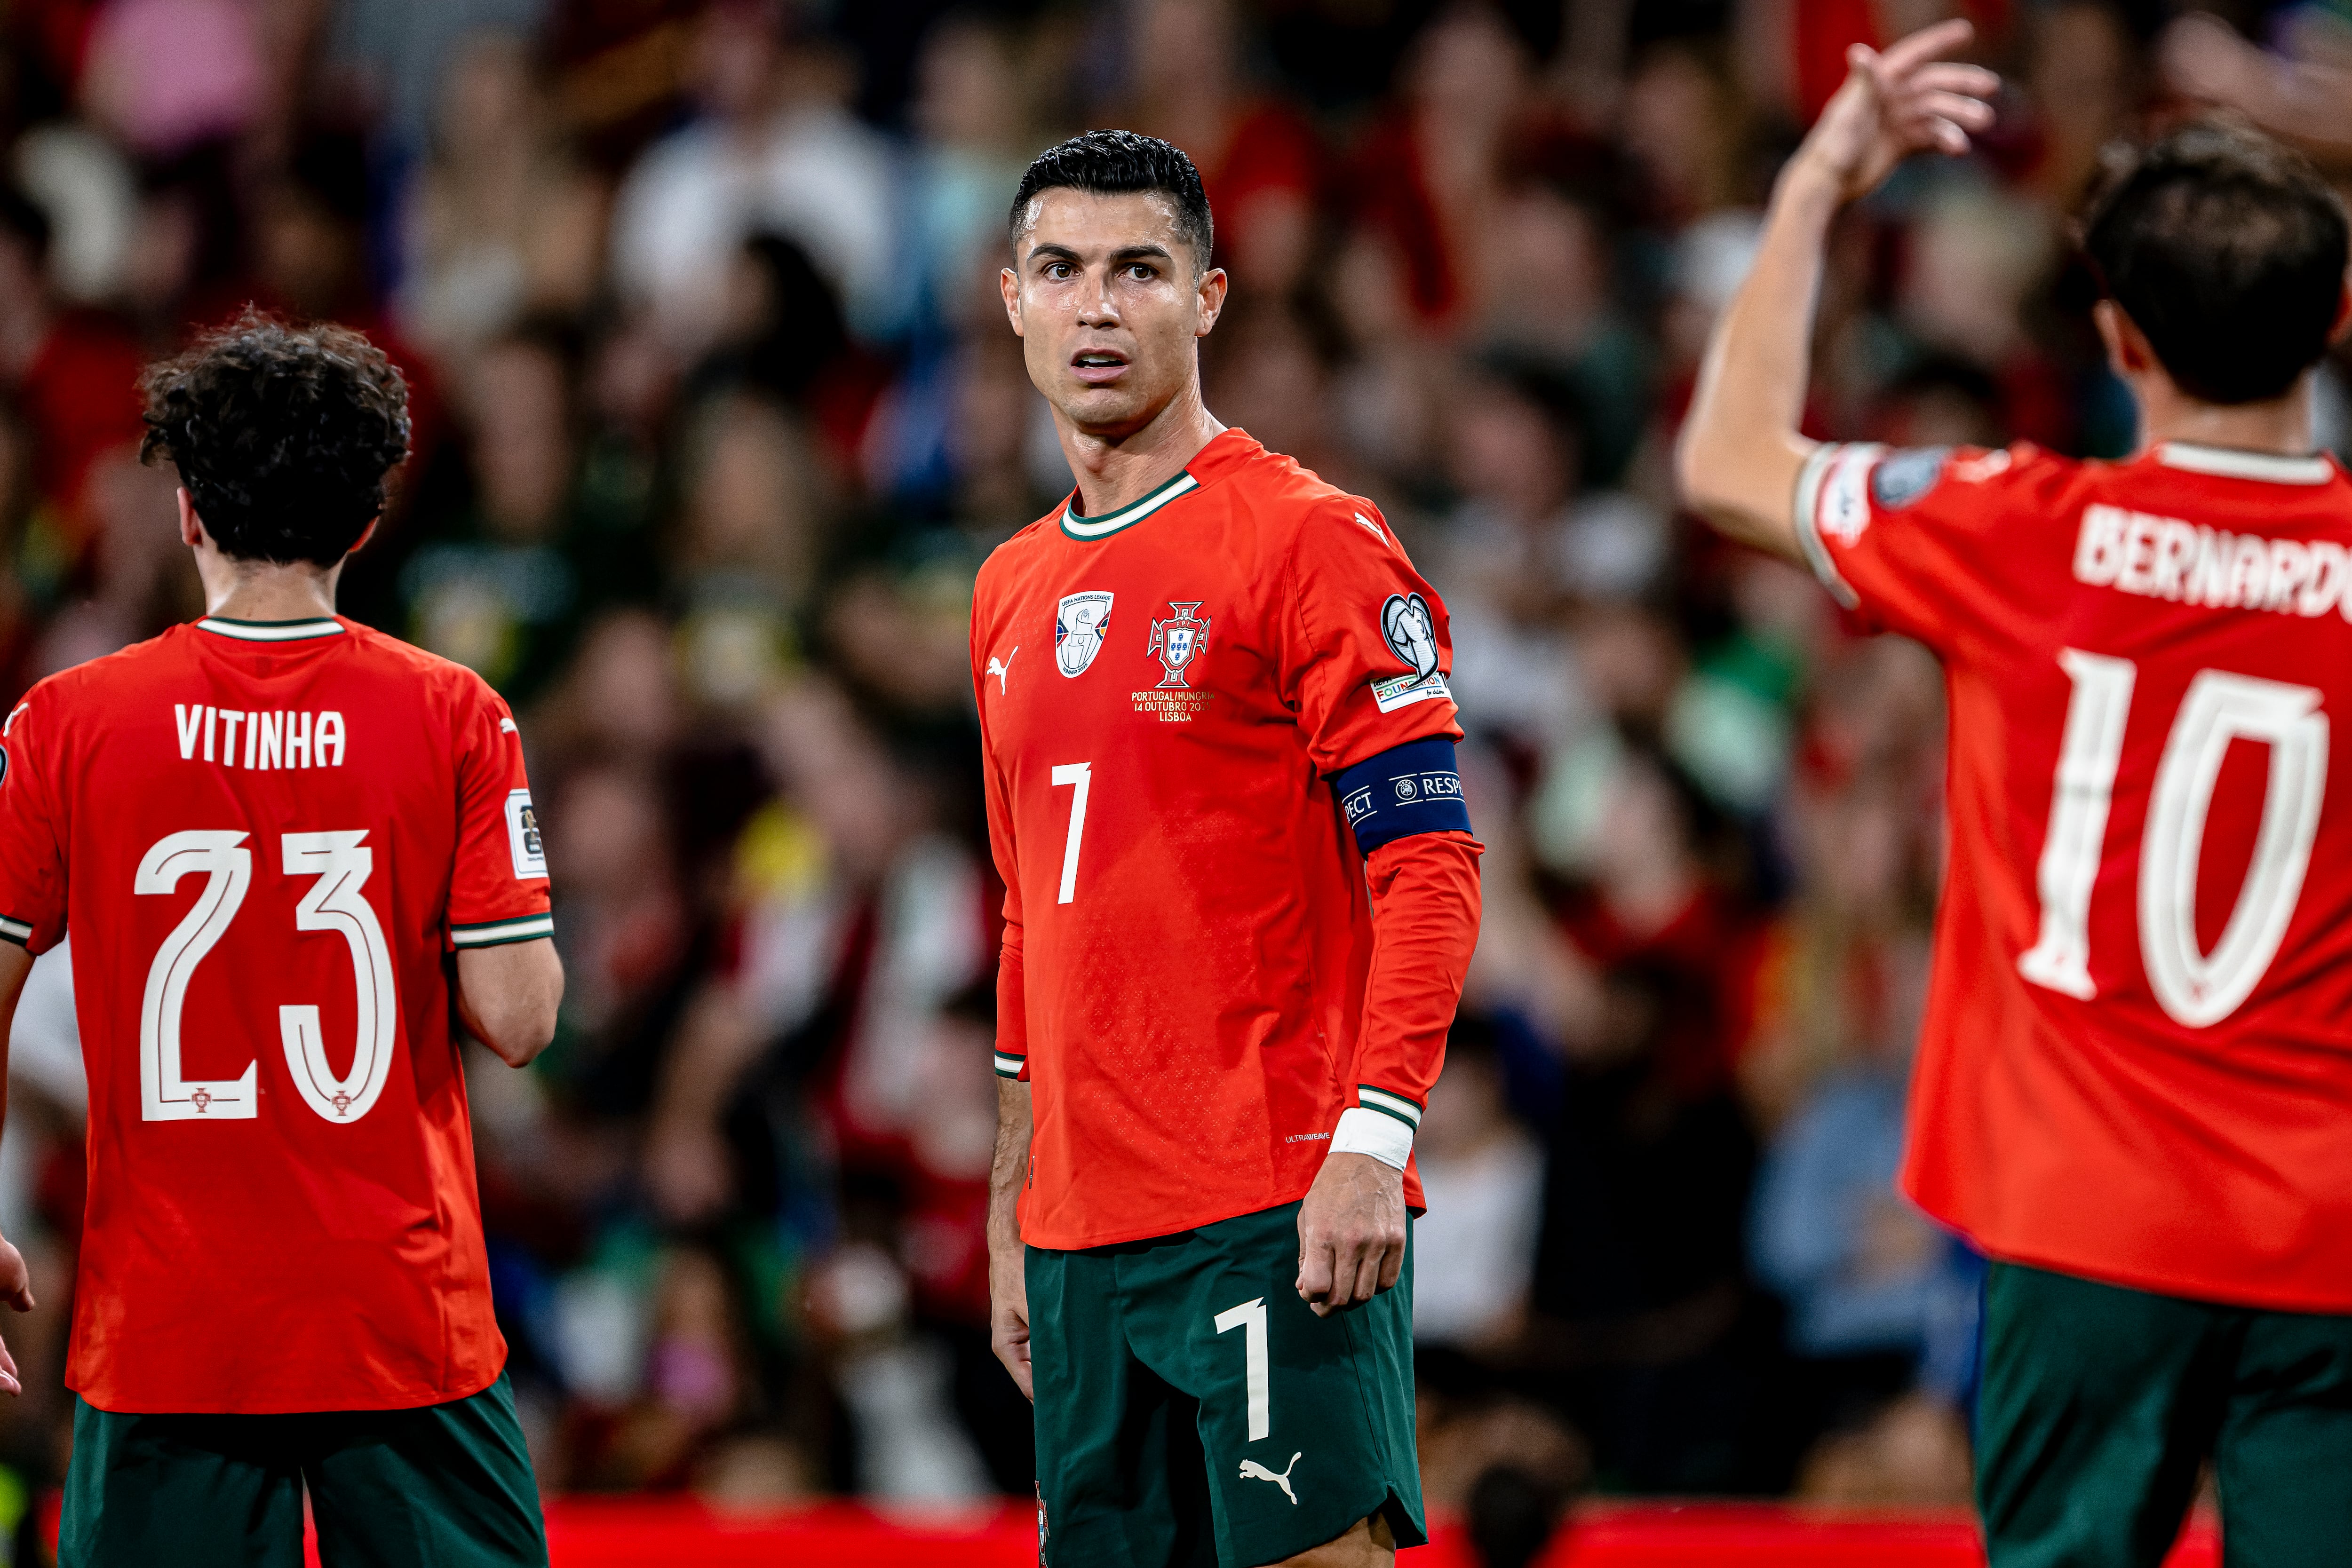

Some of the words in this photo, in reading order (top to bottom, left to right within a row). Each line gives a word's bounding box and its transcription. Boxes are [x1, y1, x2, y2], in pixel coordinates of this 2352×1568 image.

[1063, 666, 1077, 674] WINNER
[1078, 663, 1088, 673] 2025
[1132, 691, 1215, 702] PORTUGAL/HUNGRIA
[1135, 703, 1143, 712] 14
[1144, 701, 1187, 712] OUTUBRO
[1189, 702, 1210, 711] 2025
[1160, 712, 1192, 721] LISBOA
[175, 704, 345, 770] VITINHA
[1052, 761, 1091, 904] 7
[2018, 646, 2330, 1029] 10
[134, 830, 396, 1124] 23
[1285, 1132, 1330, 1143] ULTRAWEAVE
[1214, 1297, 1269, 1442] 7
